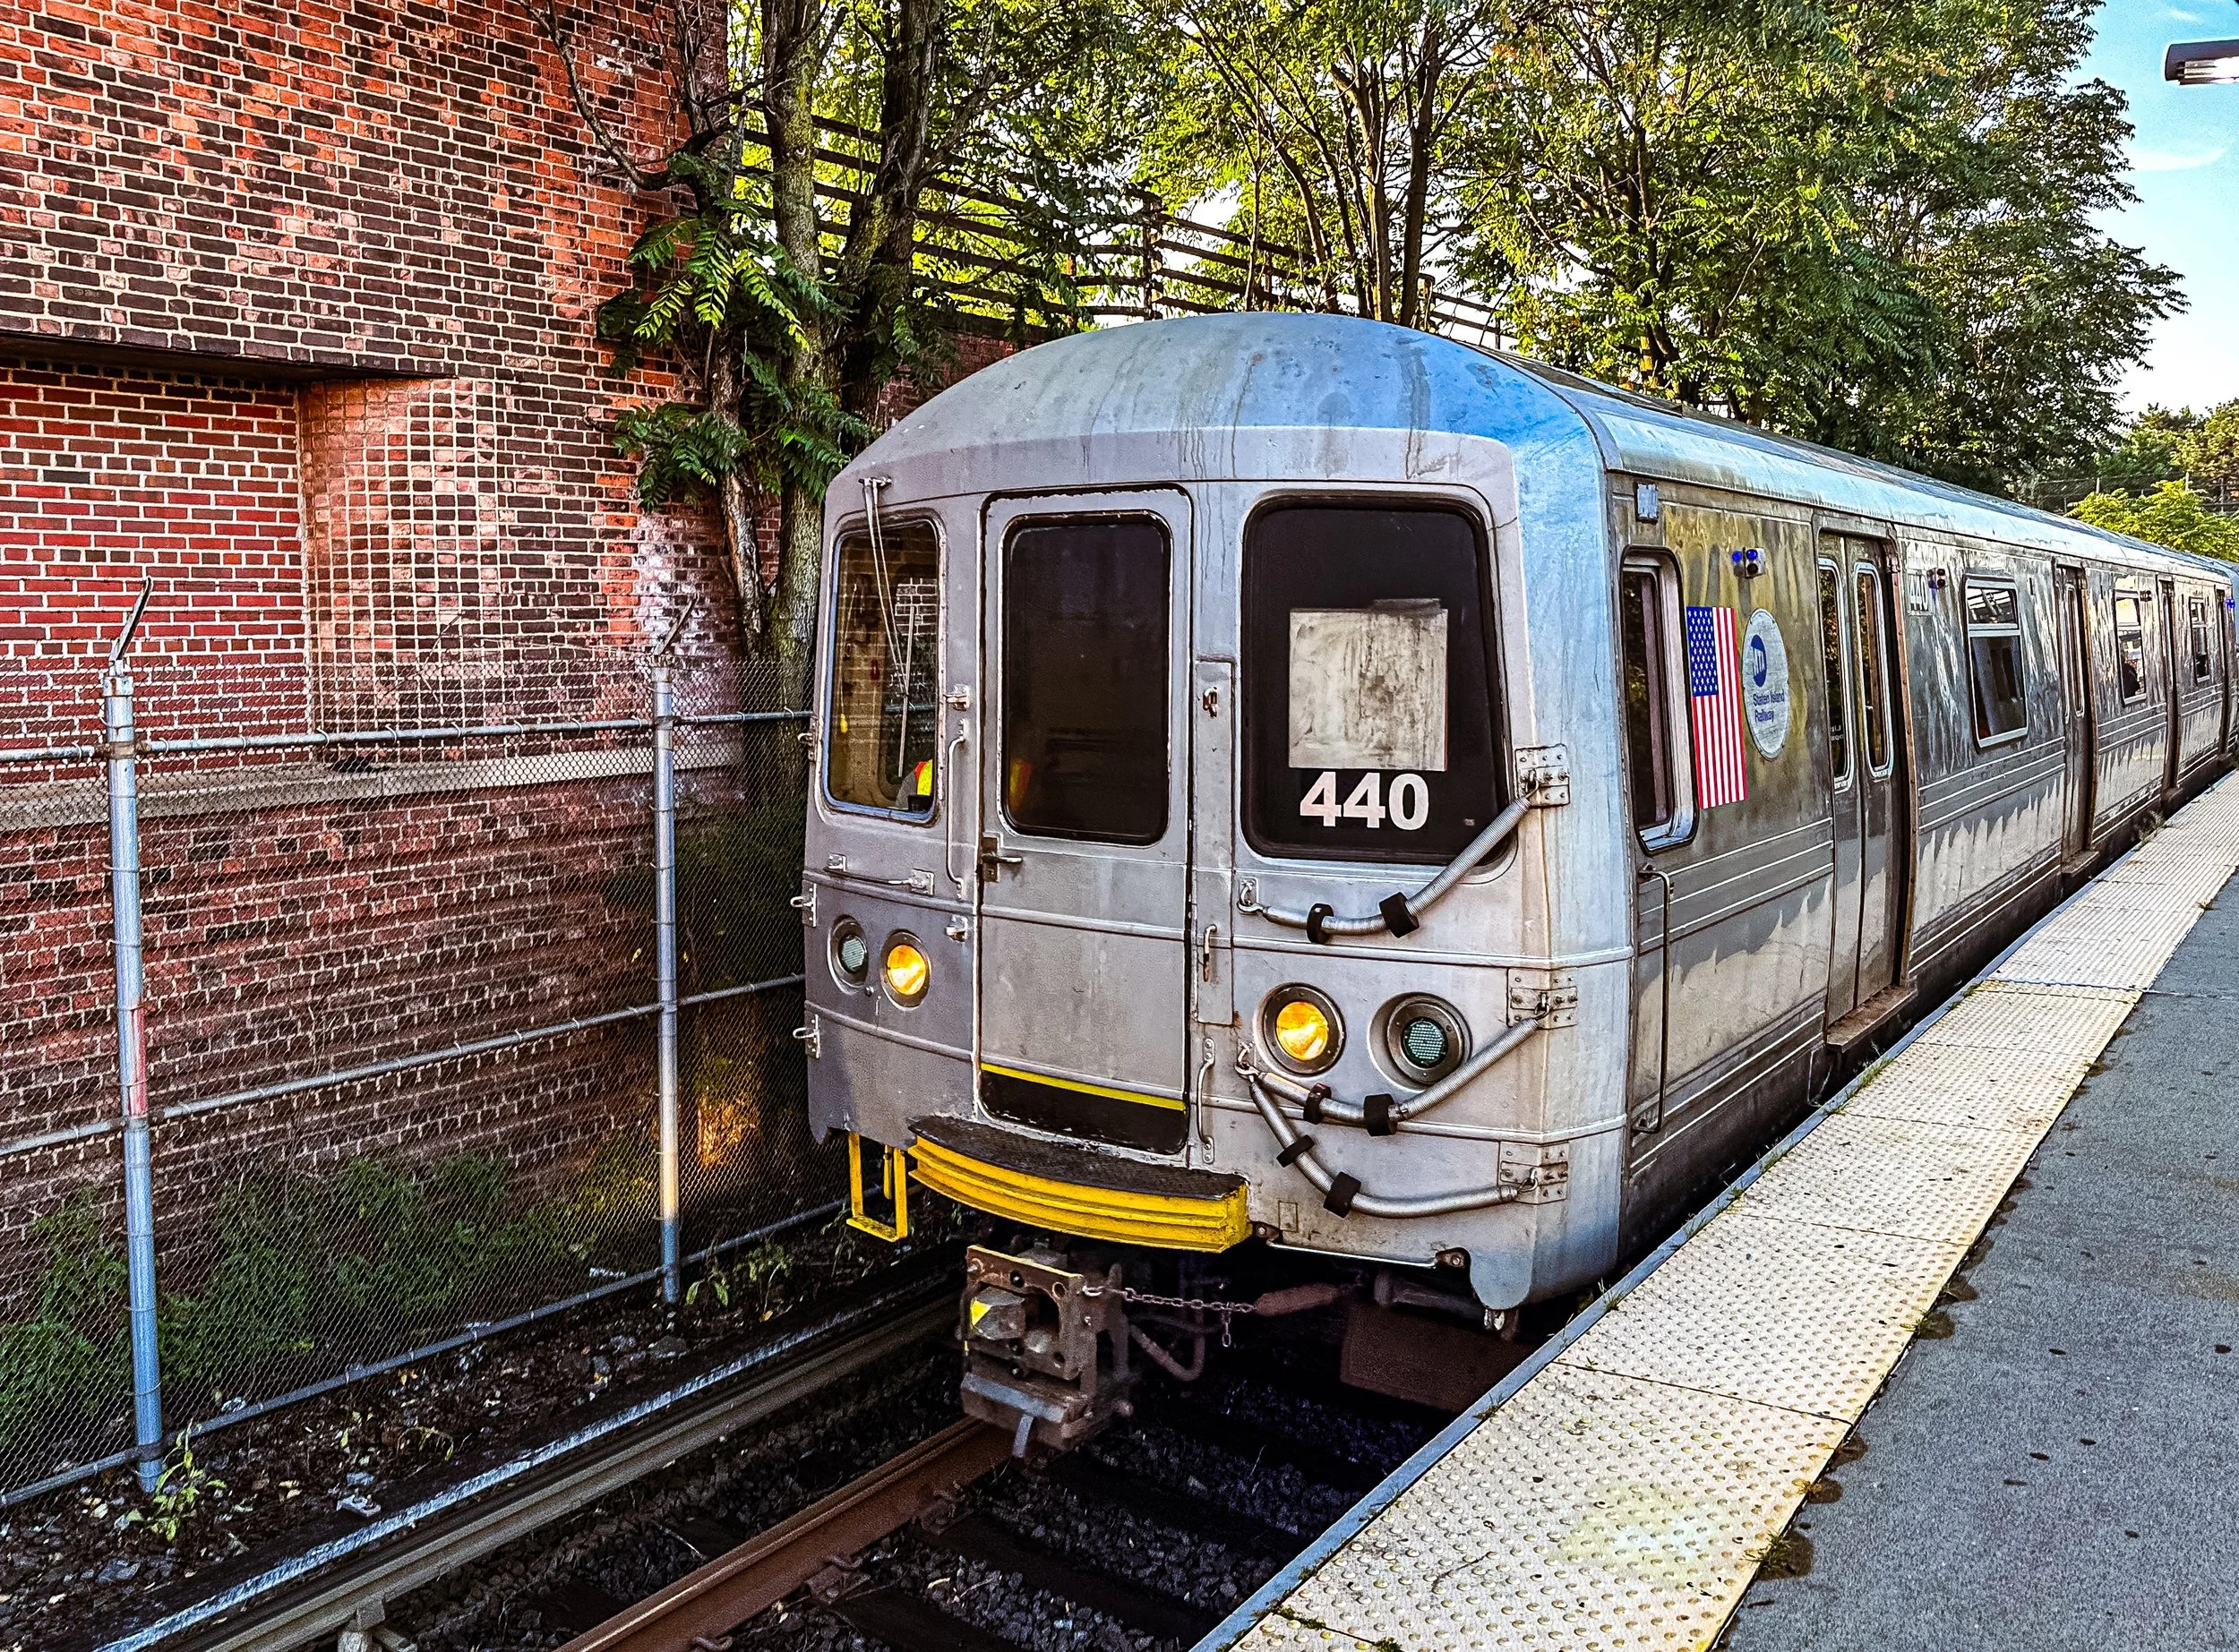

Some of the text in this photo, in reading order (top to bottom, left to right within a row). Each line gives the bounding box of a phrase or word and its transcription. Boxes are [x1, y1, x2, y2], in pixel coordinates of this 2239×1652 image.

[1909, 574, 1928, 611] 440
[1753, 689, 1785, 706] Staten Island
[1754, 709, 1774, 723] Railway
[1300, 771, 1429, 831] 440
